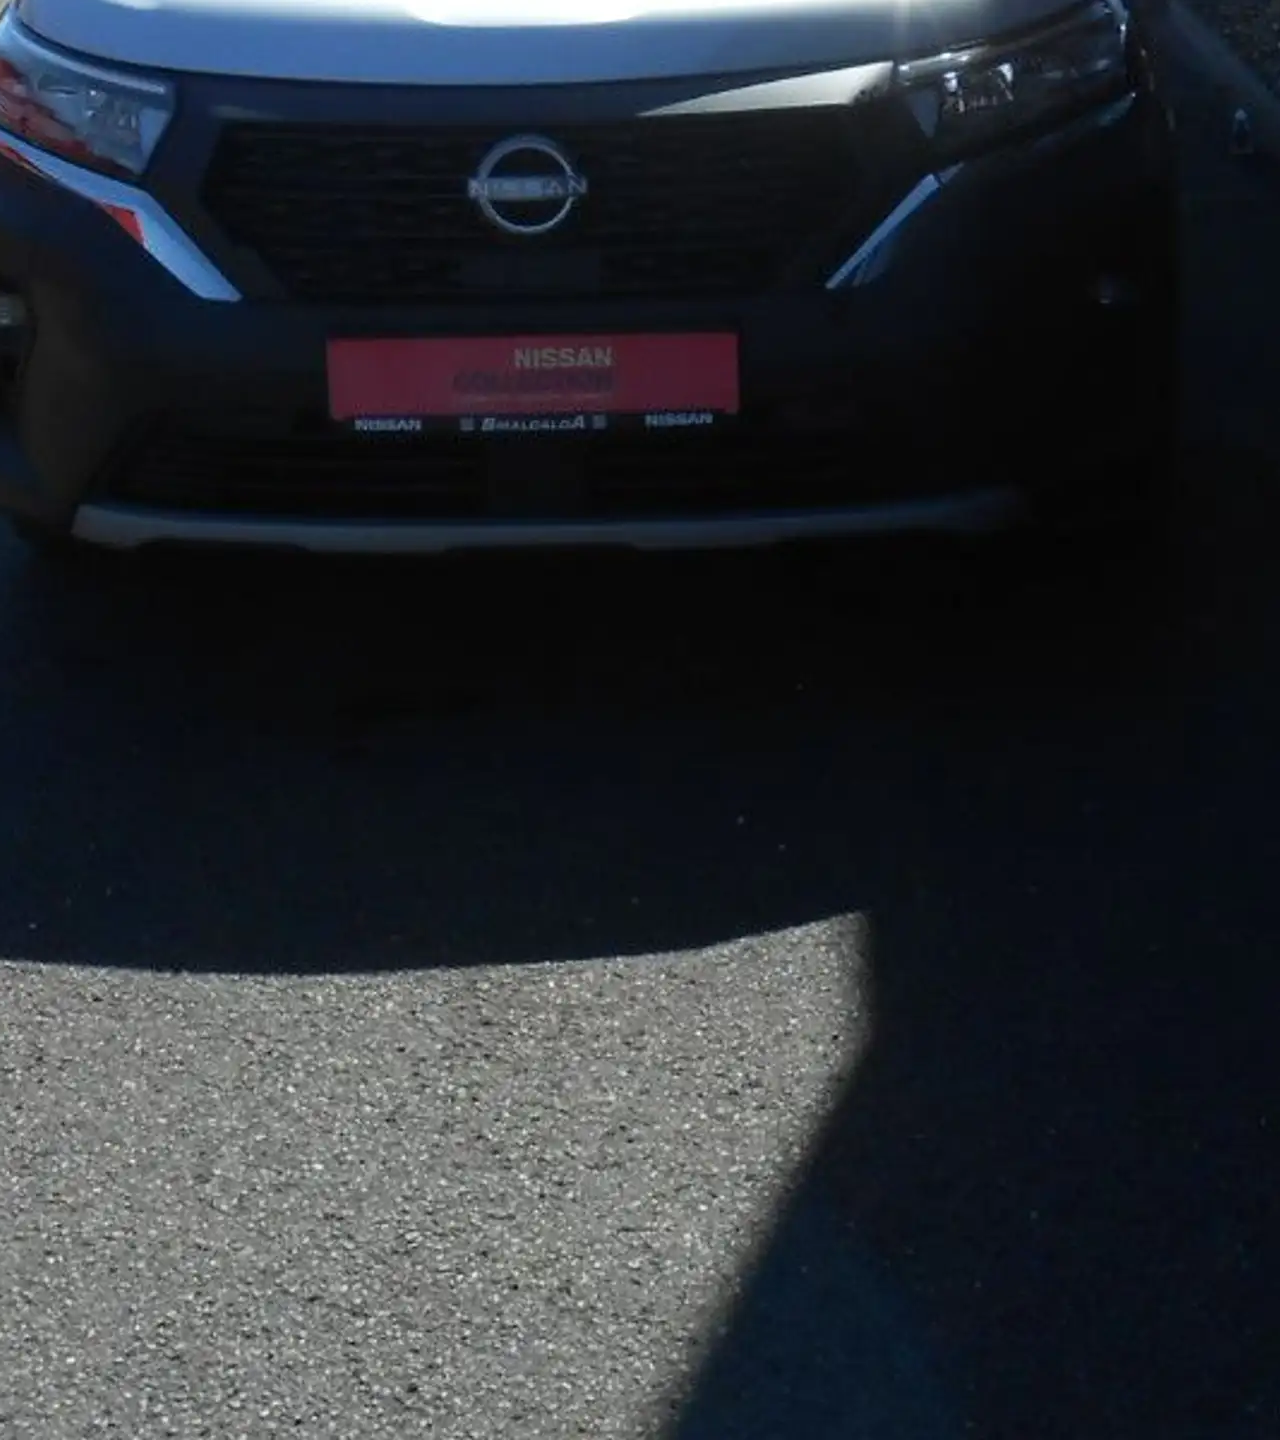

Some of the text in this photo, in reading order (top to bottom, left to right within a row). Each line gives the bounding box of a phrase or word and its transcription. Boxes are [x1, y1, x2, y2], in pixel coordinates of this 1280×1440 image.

[469, 177, 587, 198] NISSAN
[514, 347, 613, 368] NISSAN
[645, 412, 714, 427] NISSAN
